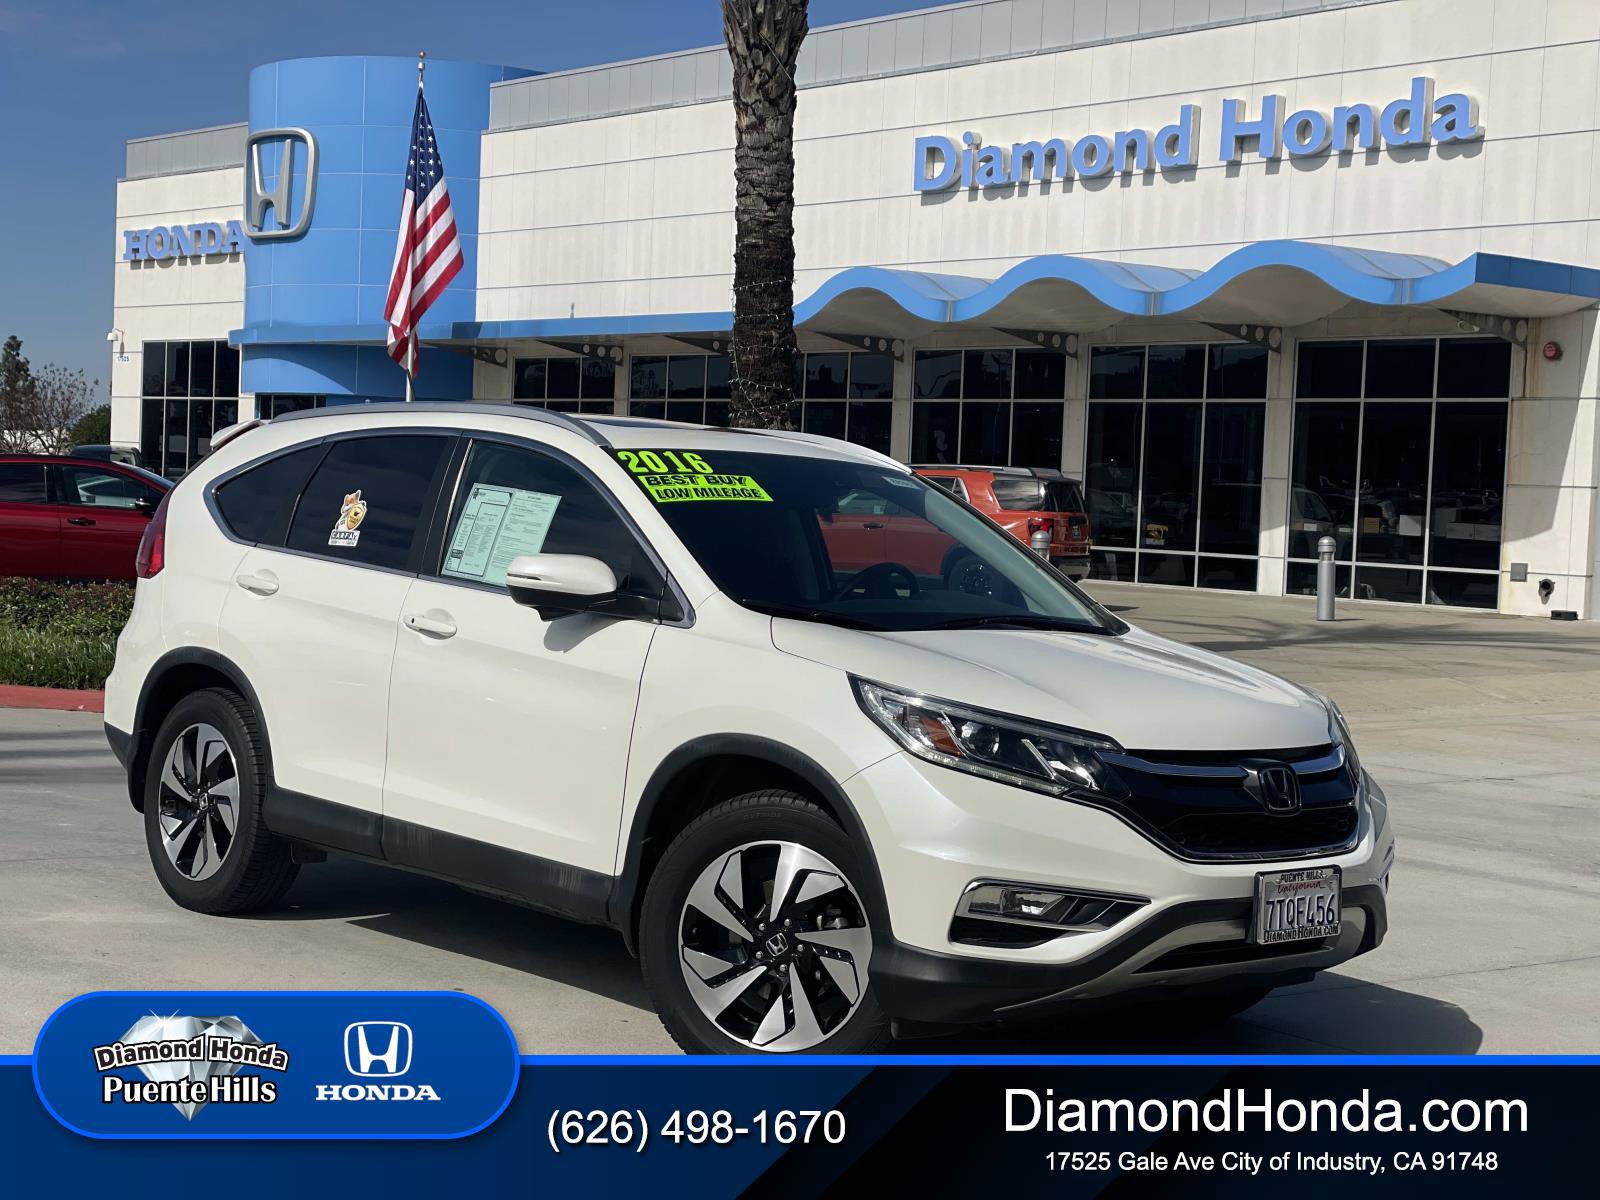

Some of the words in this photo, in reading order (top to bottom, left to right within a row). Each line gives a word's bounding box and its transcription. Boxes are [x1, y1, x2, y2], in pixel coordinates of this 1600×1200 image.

[914, 104, 1200, 192] Diamond
[1219, 76, 1484, 161] Honda
[123, 220, 244, 260] HONDA
[617, 450, 714, 474] 2016
[644, 475, 699, 486] BEST
[704, 475, 747, 486] BUY
[655, 487, 692, 500] LOW
[692, 488, 764, 500] MILEAGE
[1280, 872, 1305, 883] PUENTE
[1266, 894, 1335, 929] 7TQF456
